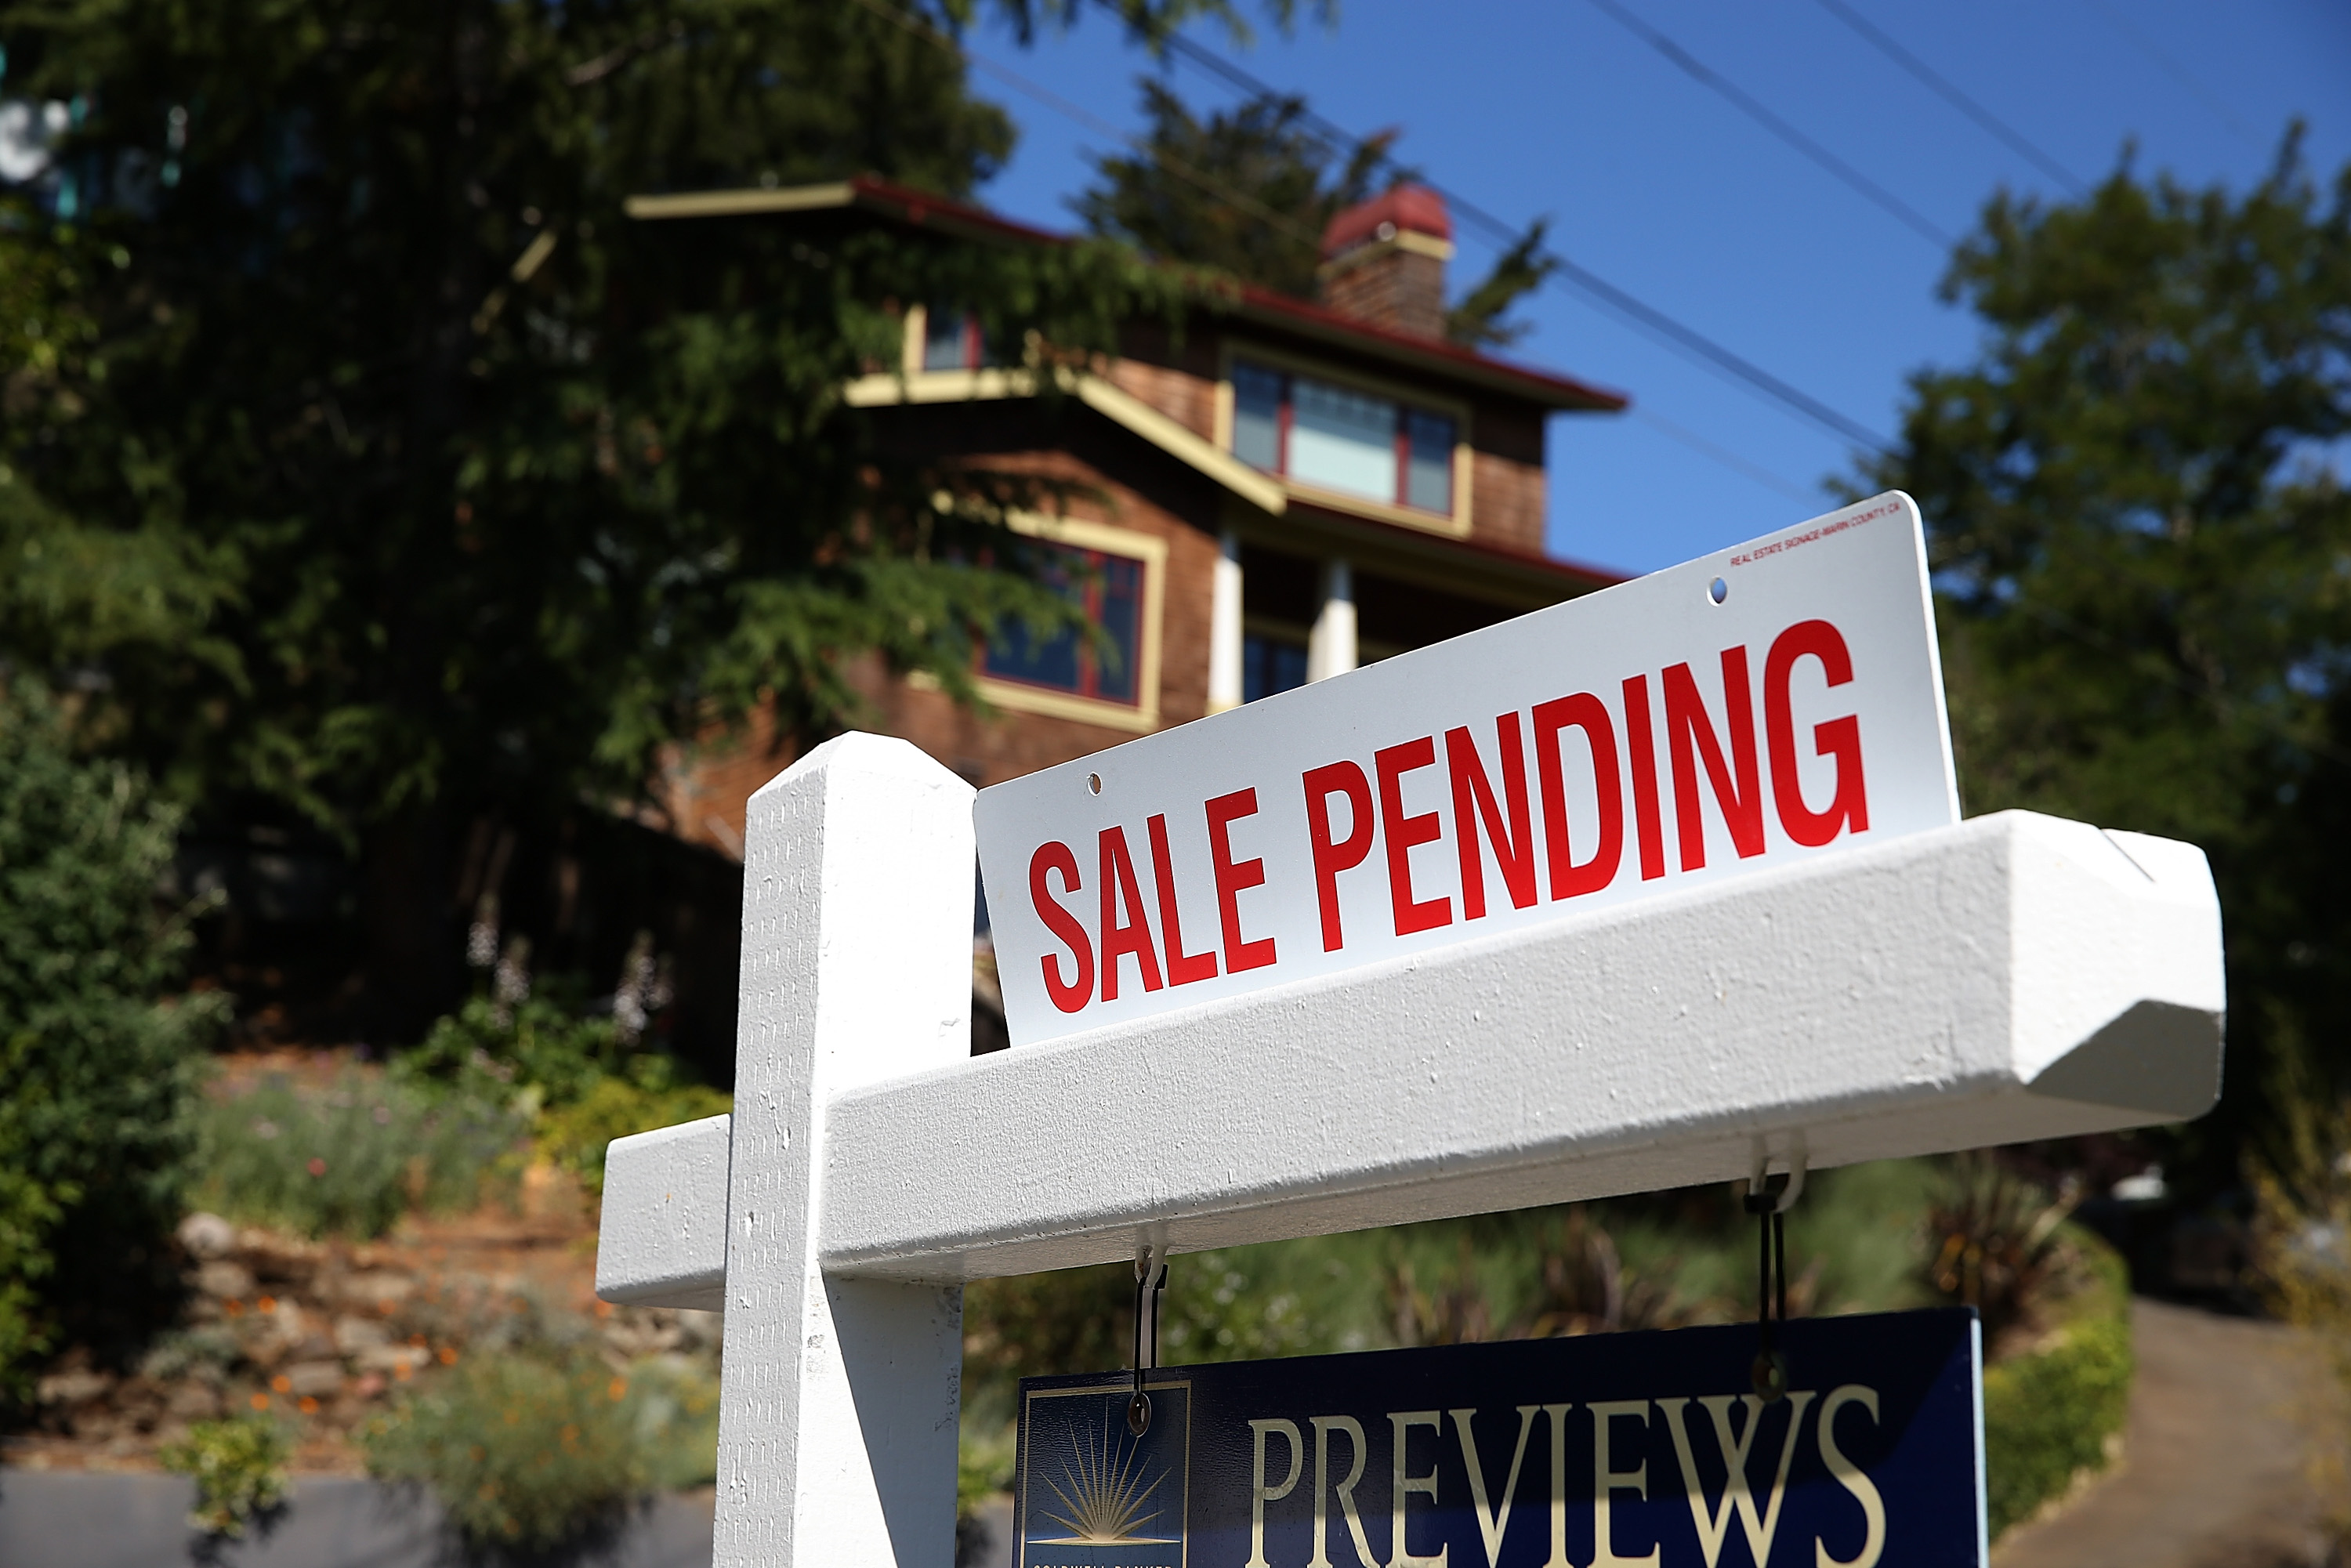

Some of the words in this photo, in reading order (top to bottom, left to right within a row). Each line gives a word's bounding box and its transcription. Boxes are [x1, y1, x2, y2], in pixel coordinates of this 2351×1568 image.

[1730, 554, 1751, 567] REAL
[1754, 542, 1783, 559] ESTATE
[1030, 788, 1277, 1013] SALE
[1302, 619, 1870, 952] PENDING
[1244, 1384, 1886, 1568] PREVIEWS
